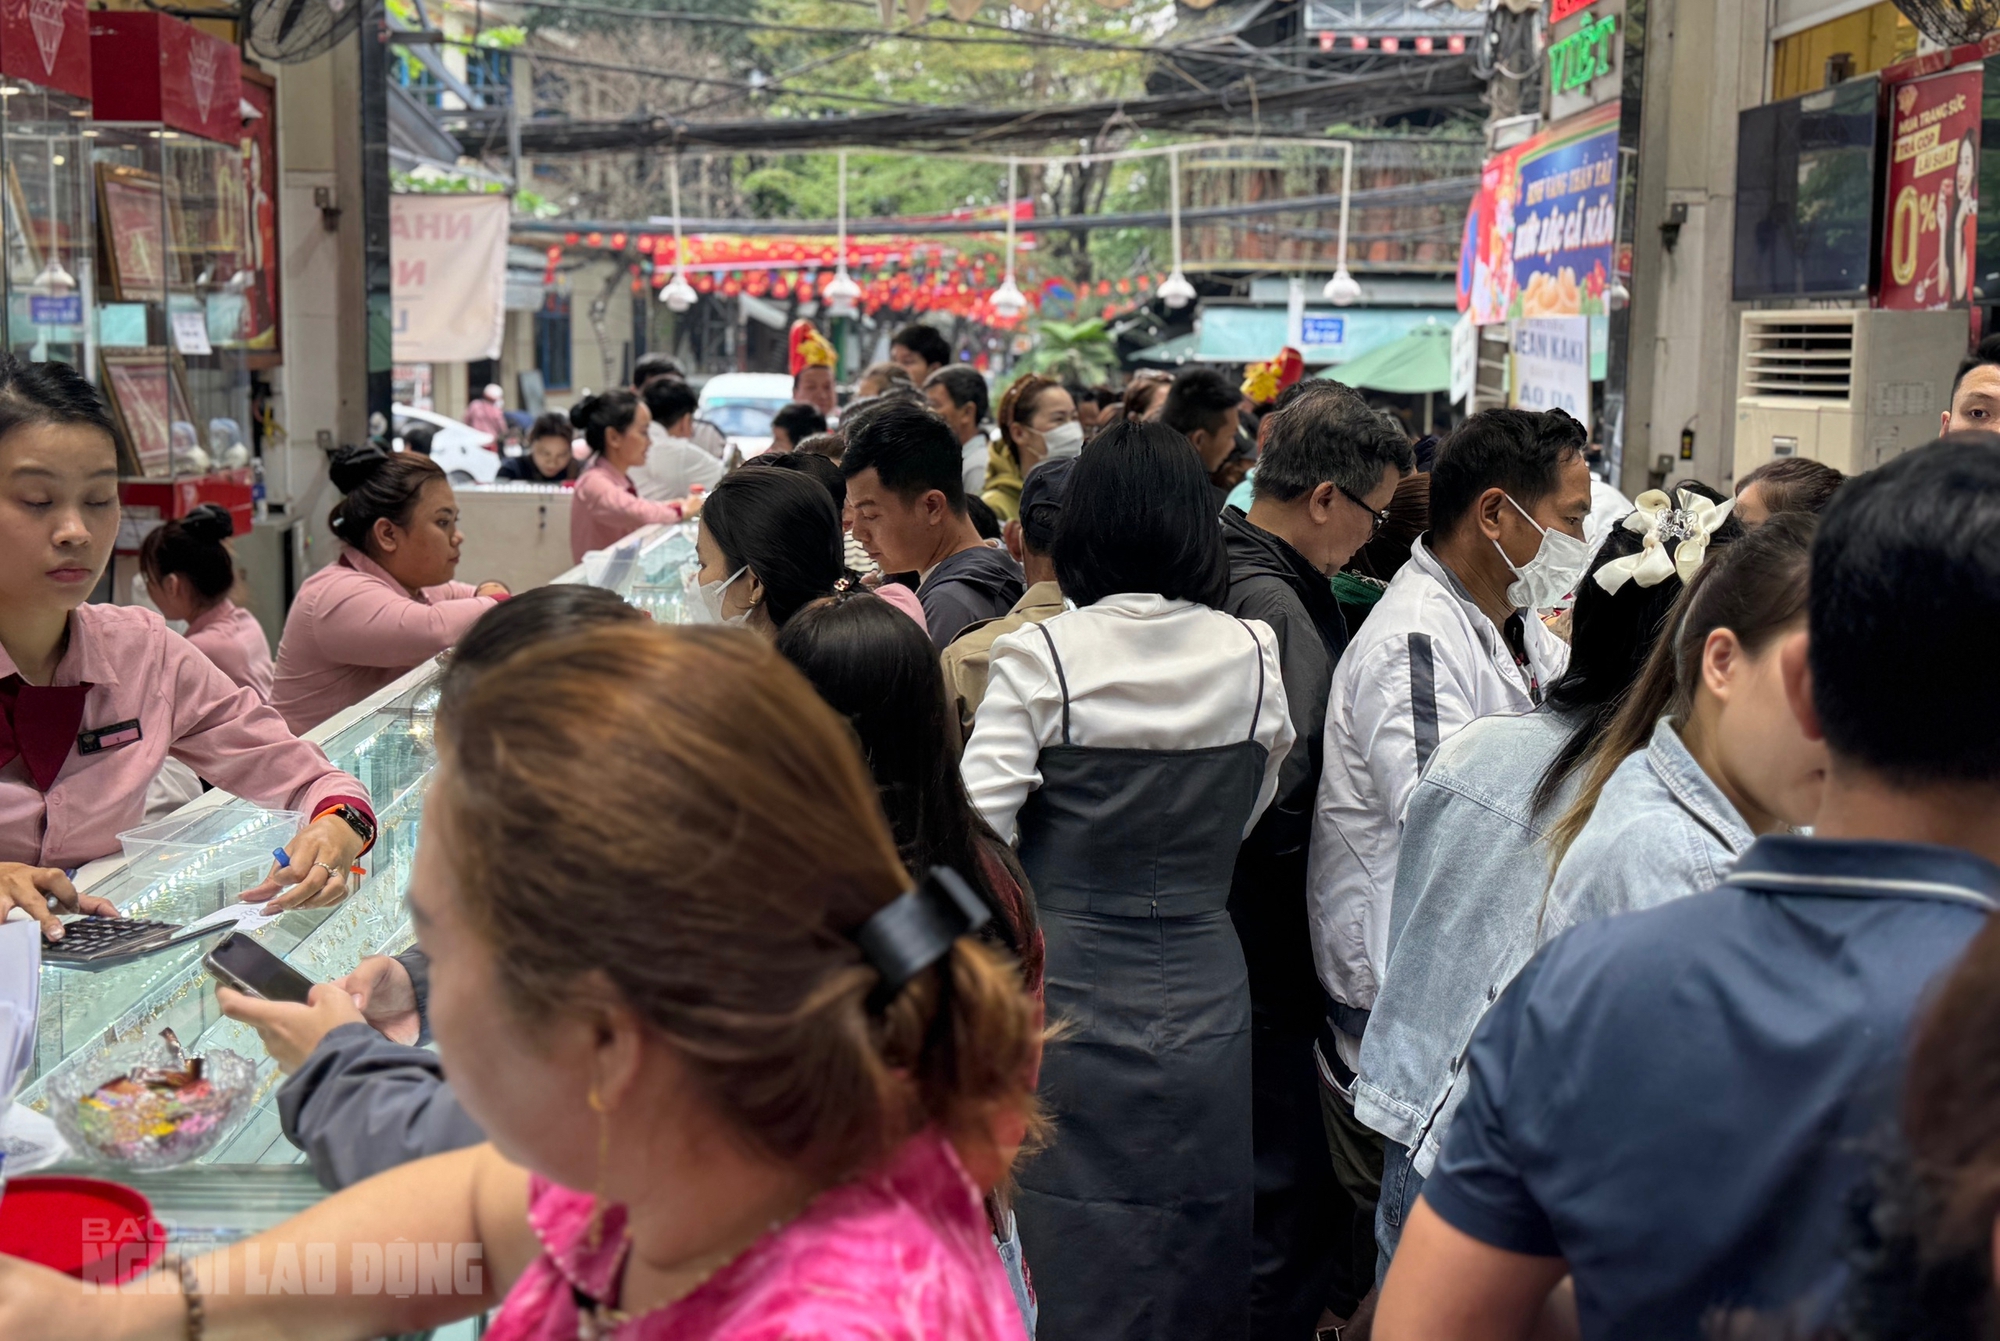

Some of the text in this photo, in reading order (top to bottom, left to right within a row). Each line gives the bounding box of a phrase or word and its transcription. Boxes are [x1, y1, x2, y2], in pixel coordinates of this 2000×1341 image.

[1548, 10, 1616, 96] VIỆT
[1919, 102, 1948, 128] TRANG
[1947, 93, 1967, 117] SỨC
[1514, 330, 1584, 366] JEAN KAKI
